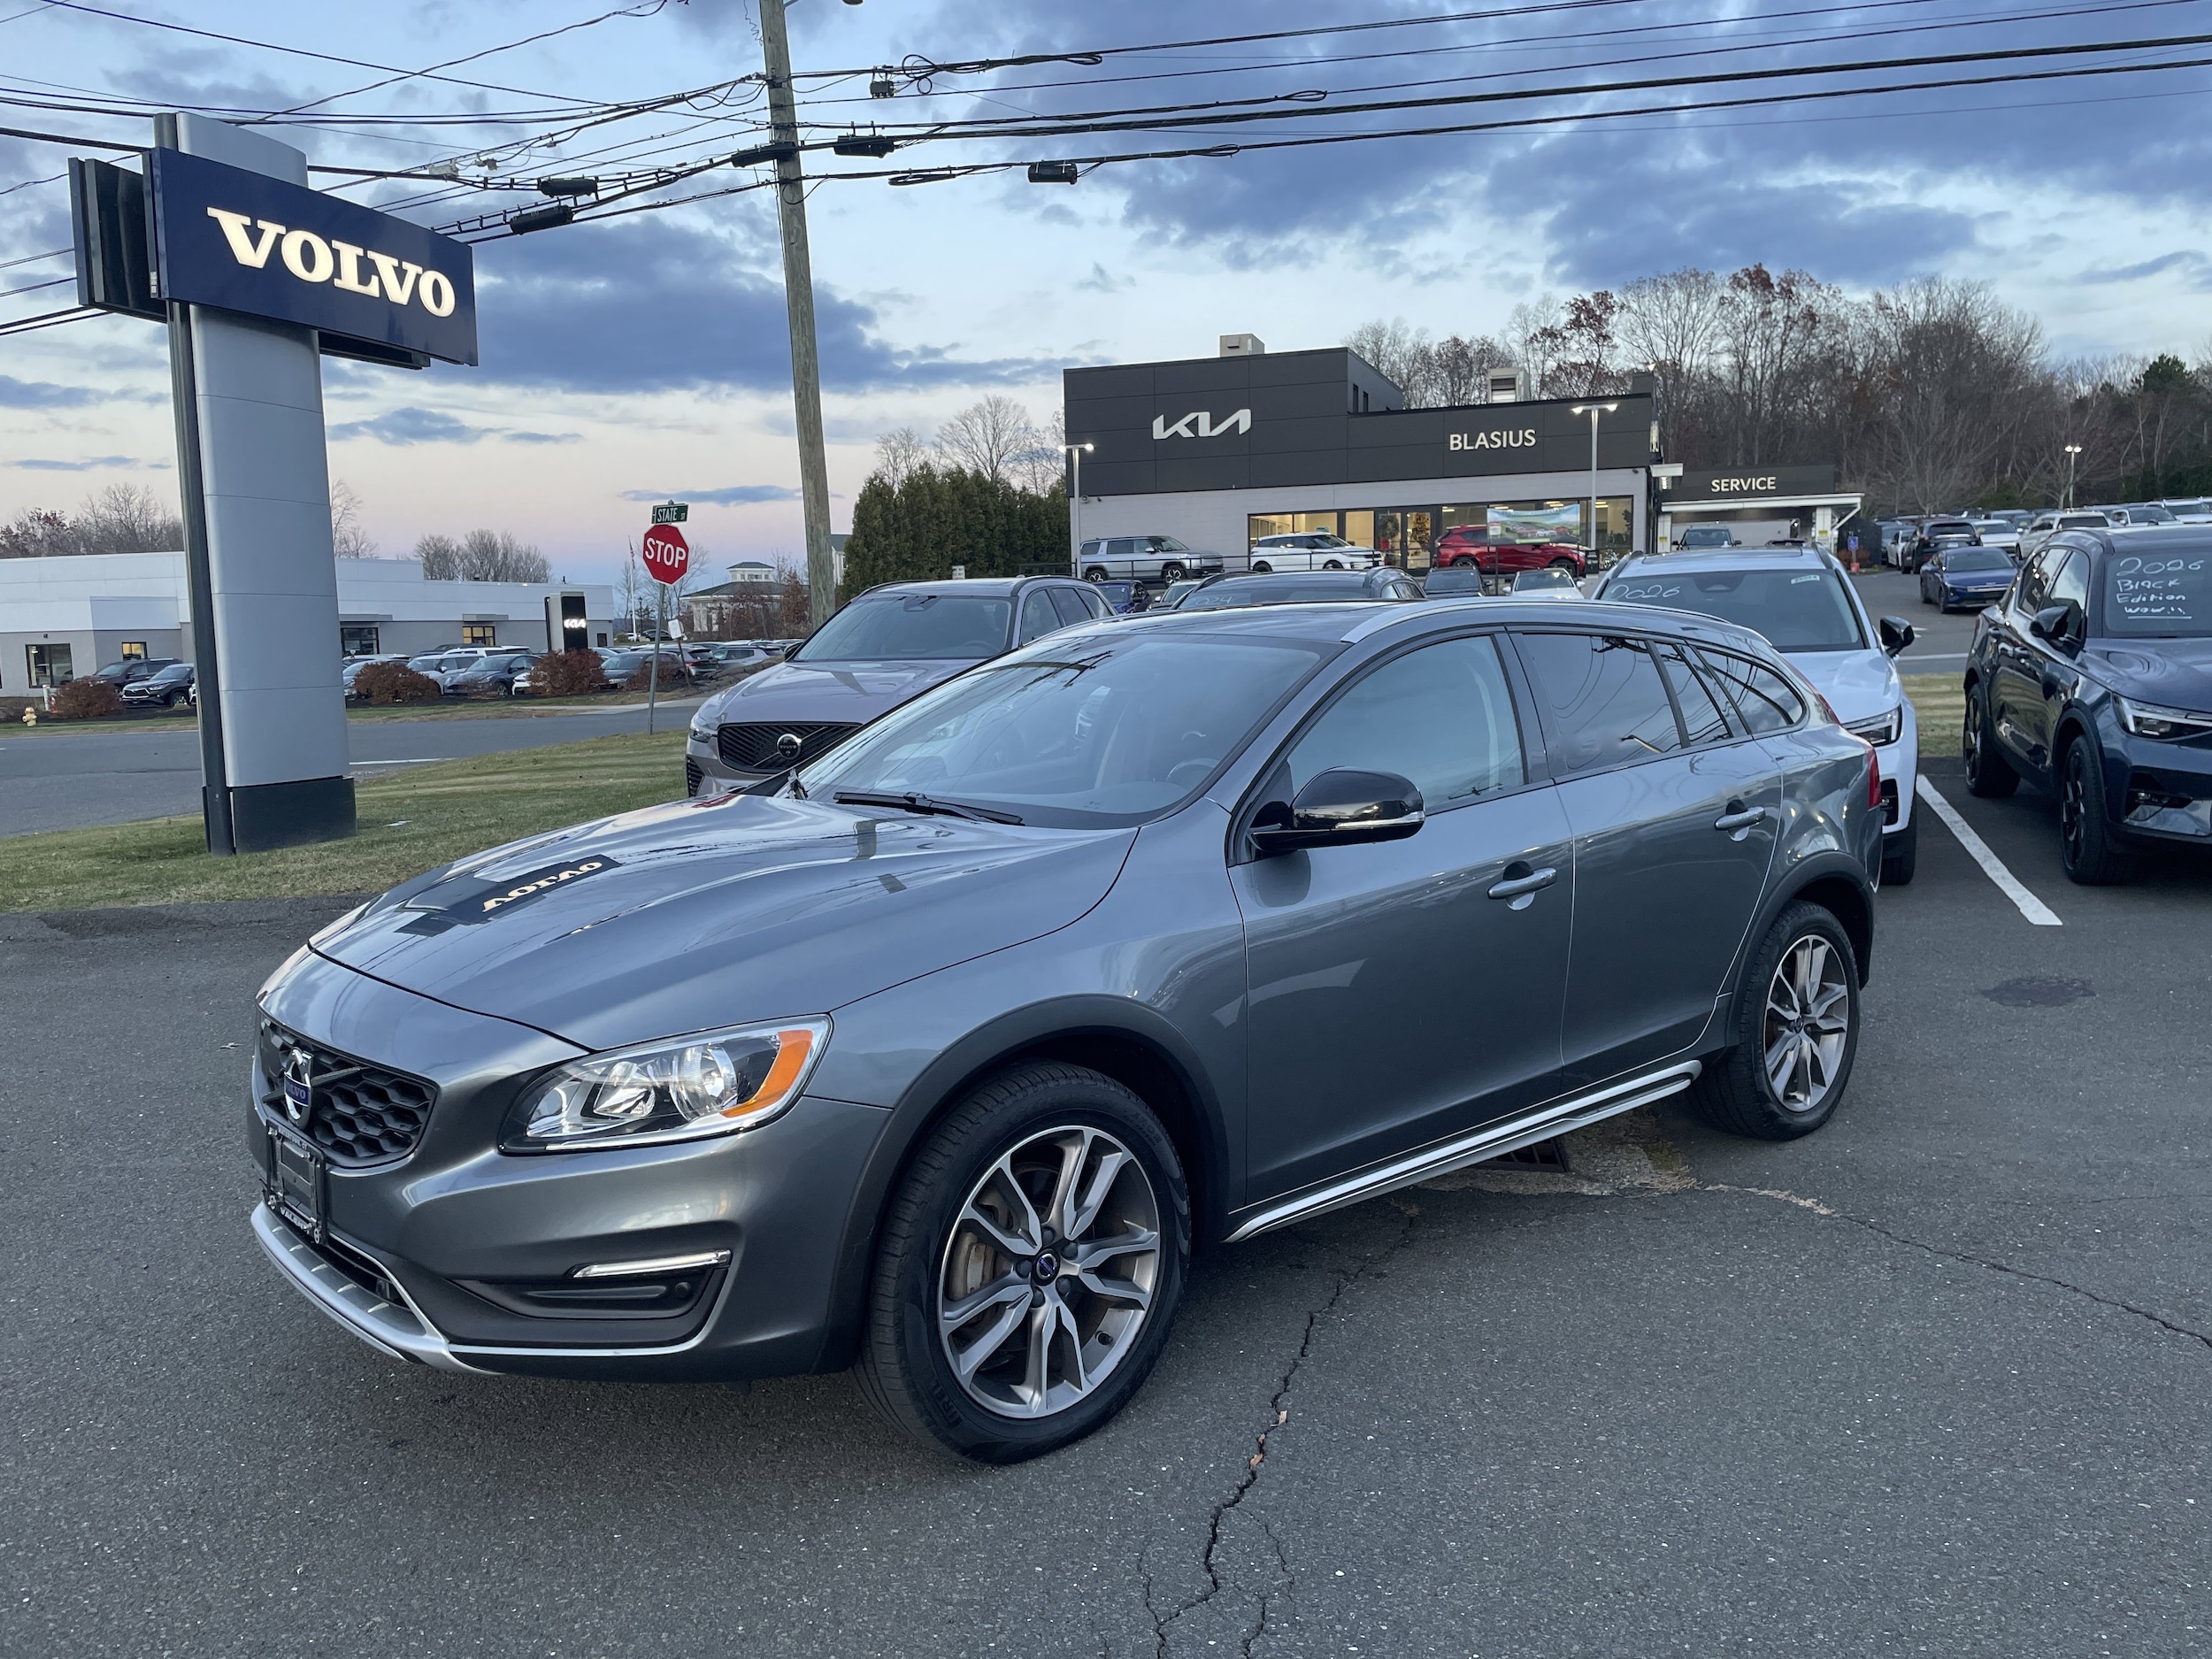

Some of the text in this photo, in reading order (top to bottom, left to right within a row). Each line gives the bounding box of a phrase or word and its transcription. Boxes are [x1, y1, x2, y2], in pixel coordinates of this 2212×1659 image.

[206, 206, 456, 318] VOLVO
[1152, 409, 1251, 440] KIA
[1448, 429, 1537, 451] BLASIUS
[1710, 477, 1777, 493] SERVICE
[657, 508, 678, 522] STATE
[645, 537, 687, 568] STOP
[2116, 557, 2205, 577] 2026
[1610, 584, 1681, 600] 2026
